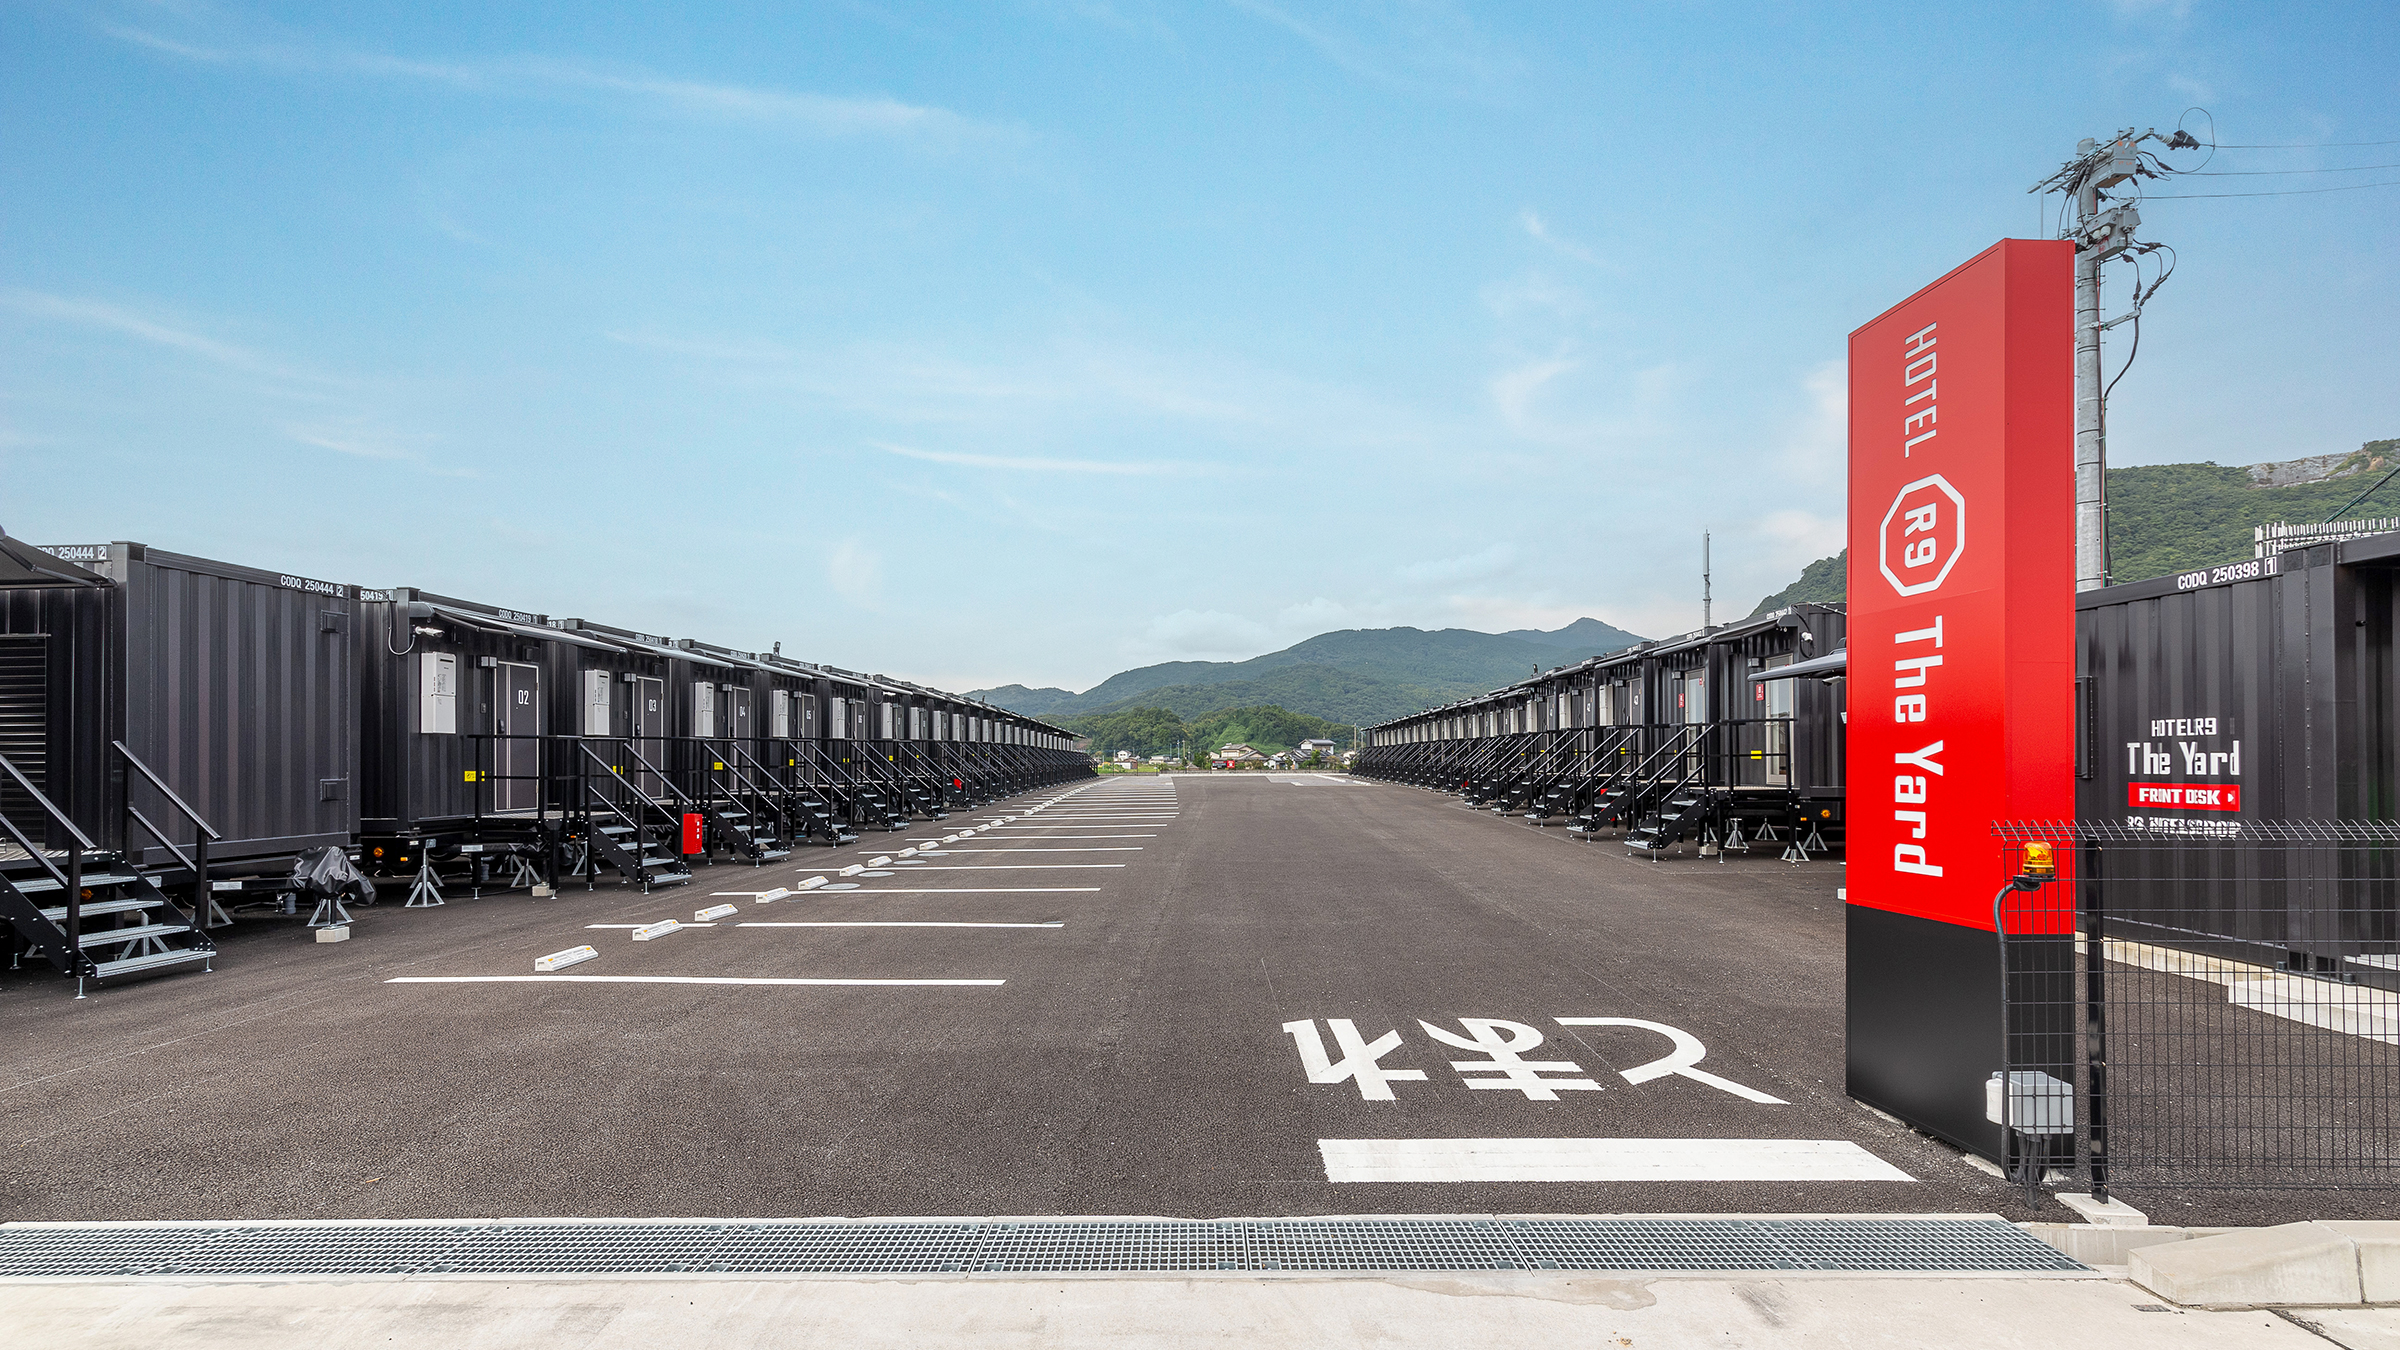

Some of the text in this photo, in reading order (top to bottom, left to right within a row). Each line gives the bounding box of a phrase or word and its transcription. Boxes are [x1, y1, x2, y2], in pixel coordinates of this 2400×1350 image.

[58, 546, 95, 560] 250444
[2177, 556, 2277, 590] CODQ 250398 1
[305, 579, 334, 595] 250444
[1894, 321, 1943, 878] HOTEL R9 The Yard
[518, 689, 530, 705] 02
[648, 698, 657, 712] 03
[2126, 740, 2240, 776] The Yard
[1282, 1016, 1792, 1105] とまれ
